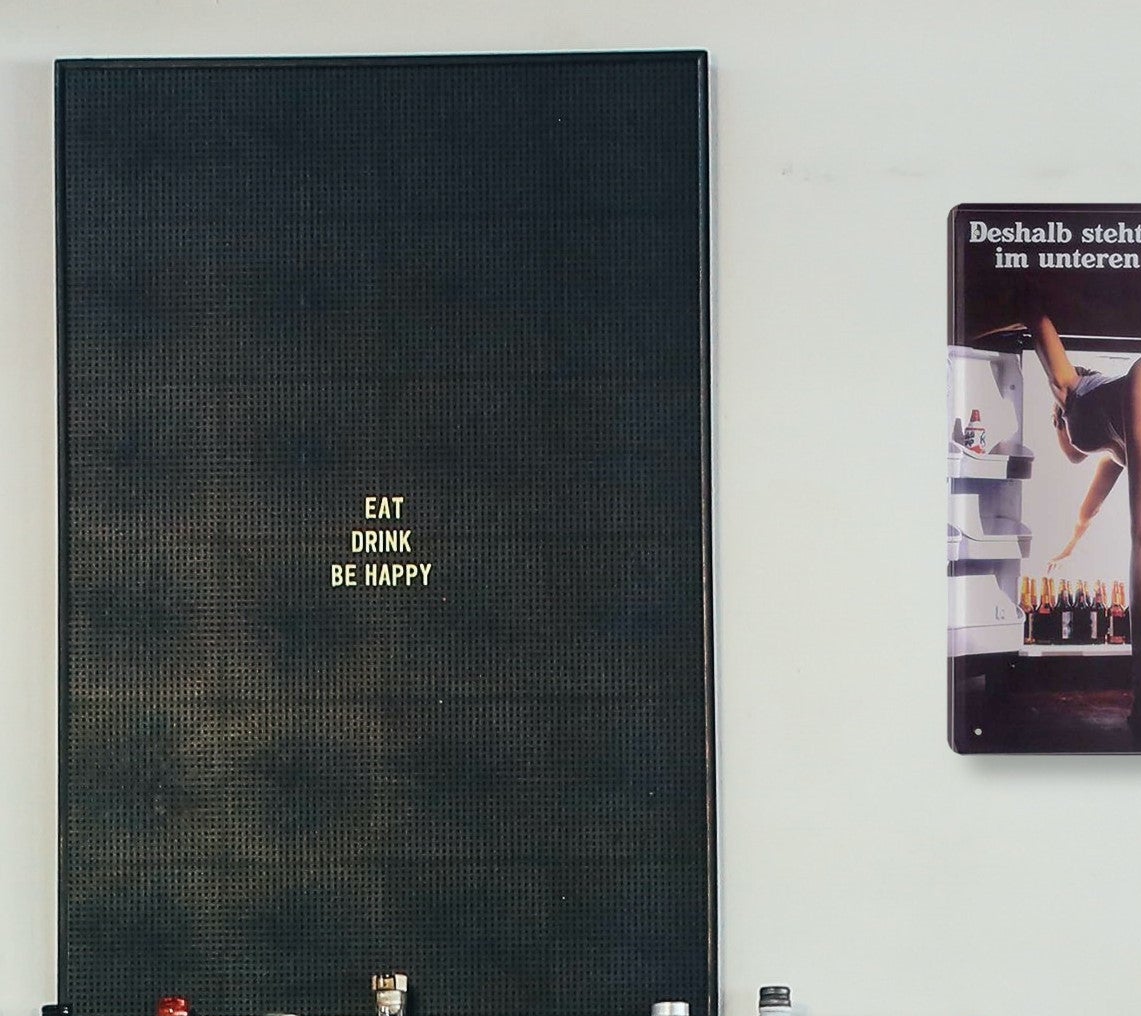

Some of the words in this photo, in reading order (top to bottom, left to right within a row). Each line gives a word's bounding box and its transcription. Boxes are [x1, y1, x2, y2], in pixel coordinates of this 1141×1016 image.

[970, 221, 1072, 243] Deshalb
[995, 247, 1029, 268] im
[1039, 249, 1140, 268] unteren
[366, 497, 403, 519] EAT
[352, 530, 411, 553] DRINK
[332, 564, 357, 587] BE
[366, 564, 431, 586] HAPPY
